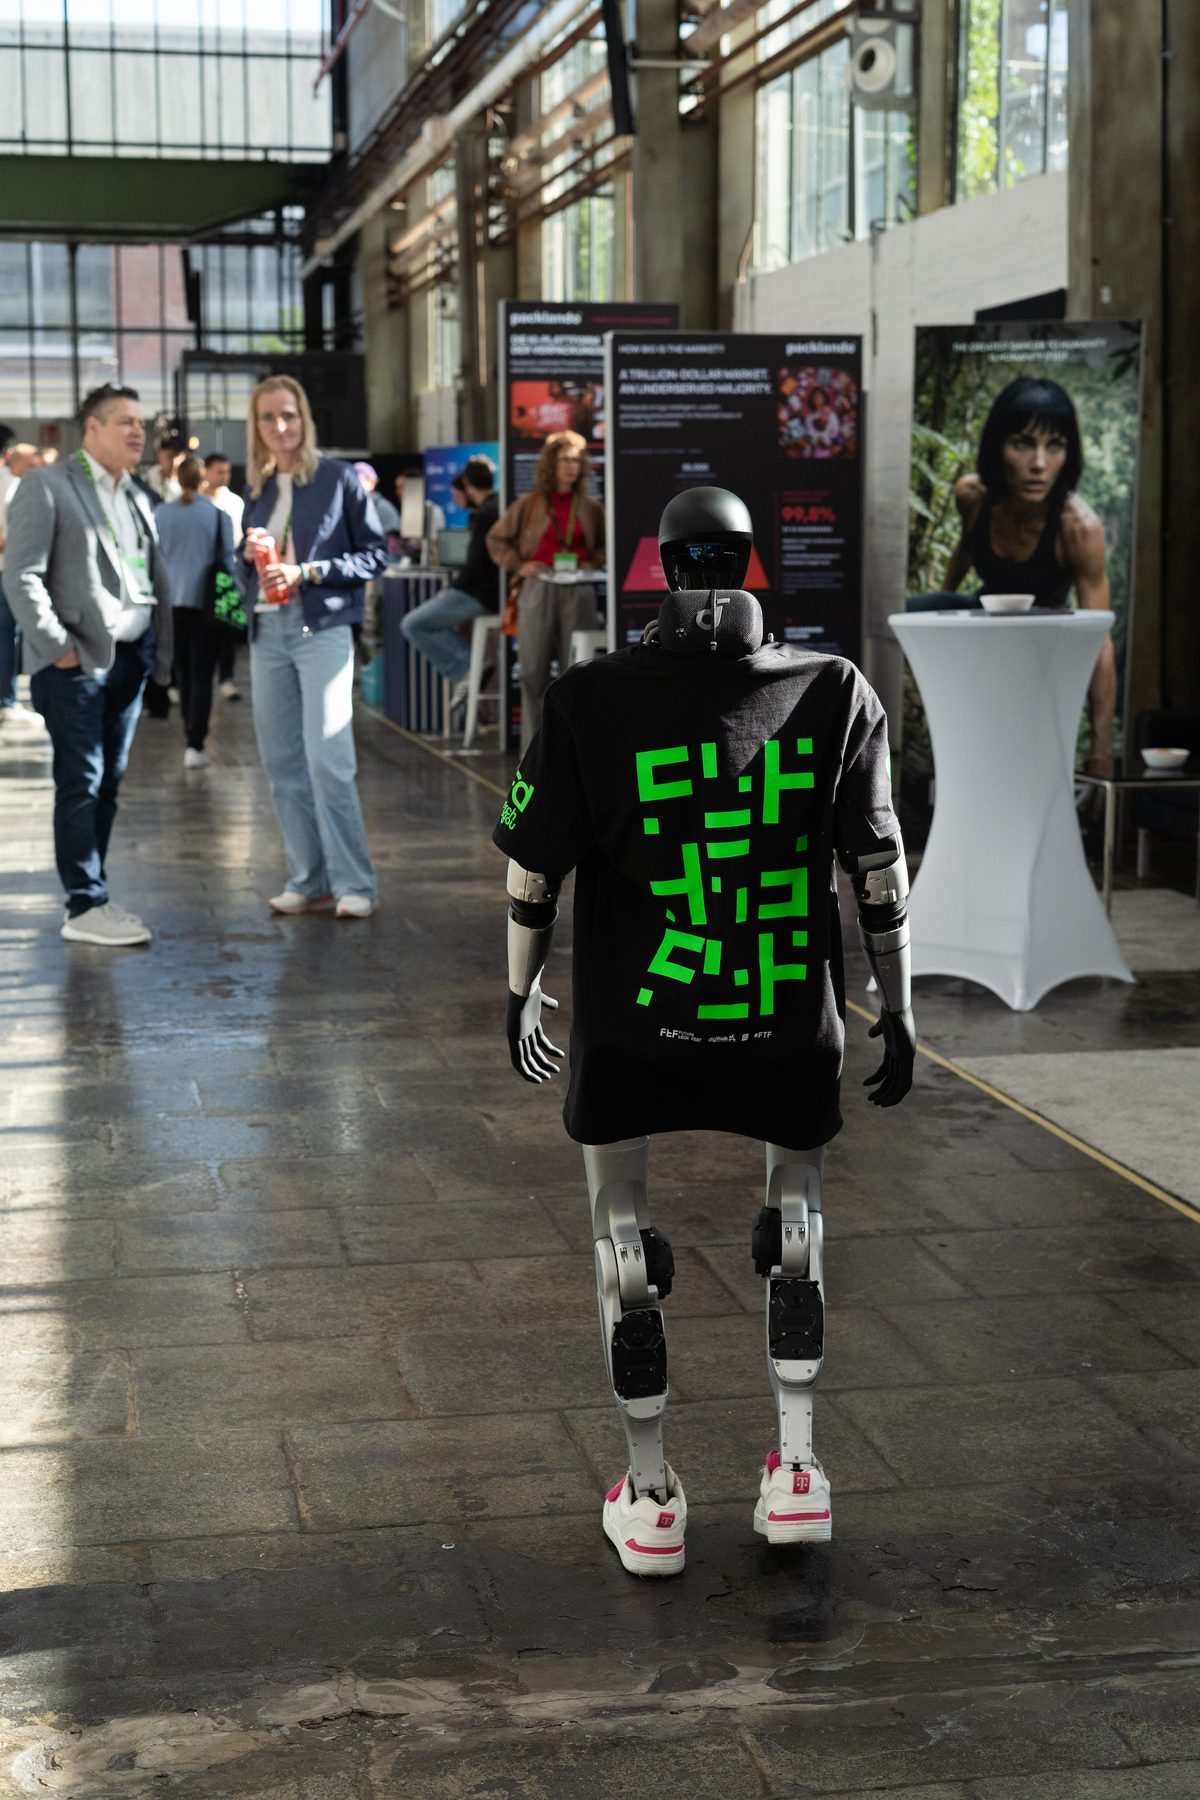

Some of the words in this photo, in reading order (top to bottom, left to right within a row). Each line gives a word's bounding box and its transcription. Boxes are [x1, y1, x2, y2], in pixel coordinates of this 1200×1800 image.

[510, 311, 582, 327] packlando
[619, 344, 639, 354] HOW
[667, 344, 684, 354] THE
[786, 341, 855, 356] packlando
[619, 368, 628, 380] A
[723, 368, 770, 380] MARKET.
[619, 383, 636, 395] AN
[638, 383, 715, 395] UNDERSERVED
[716, 383, 772, 395] MAJORITY.
